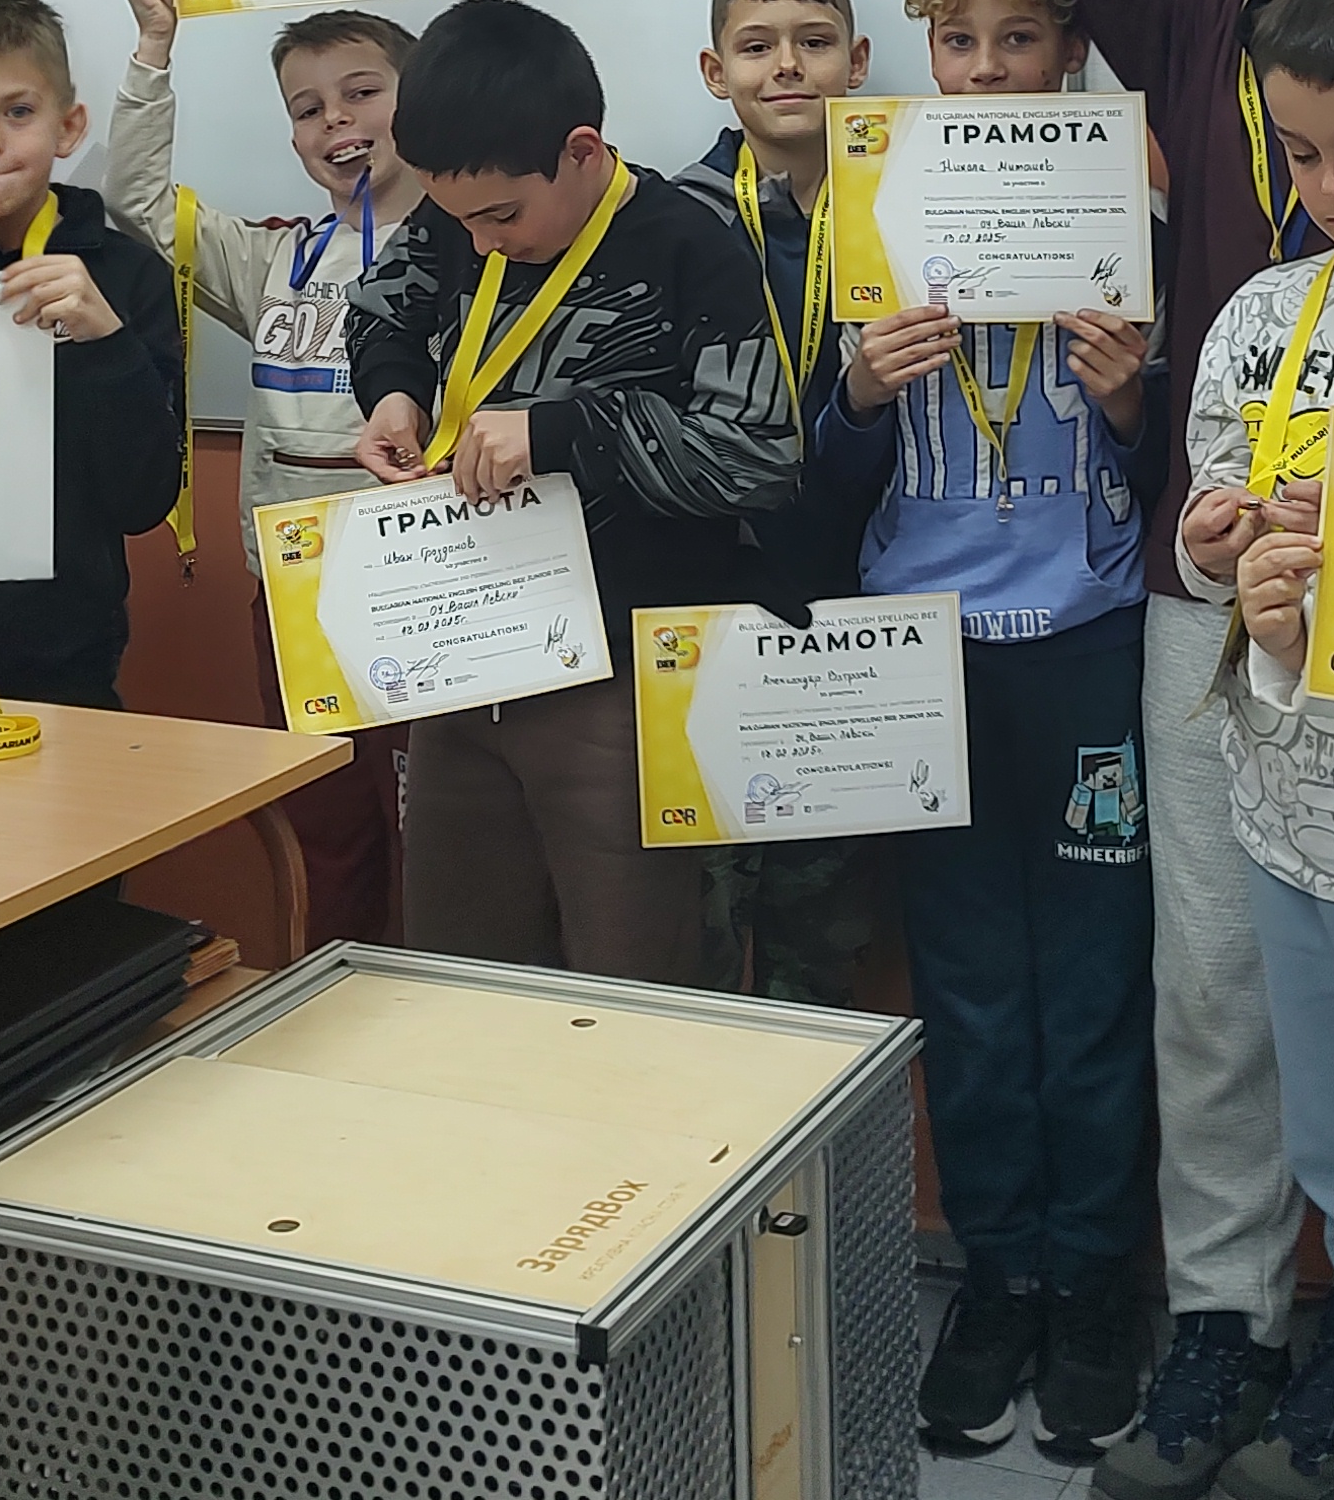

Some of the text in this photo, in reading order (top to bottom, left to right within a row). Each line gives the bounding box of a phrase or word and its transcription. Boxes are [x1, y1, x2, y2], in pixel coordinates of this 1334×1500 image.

[925, 109, 1124, 121] BULGARIAN NATIONAL ENGLISH SPELLING BEE
[942, 121, 1109, 146] ГРАМОТА
[977, 252, 1075, 261] CONGRATULATIONS!
[299, 280, 348, 301] ACHIEV
[849, 285, 883, 303] COR
[255, 302, 351, 360] GOA
[357, 491, 455, 517] BULGARIAN NATIONAL
[376, 485, 543, 539] ГРАМОТА
[877, 611, 920, 625] SPELLING
[920, 609, 939, 621] BEE
[963, 607, 1054, 640] DWIDE
[431, 622, 529, 650] CONGRATULATIONS!
[755, 625, 924, 657] ГРАМОТА
[303, 694, 341, 717] COR
[660, 807, 697, 827] COR
[516, 1179, 650, 1274] ЗарядBox
